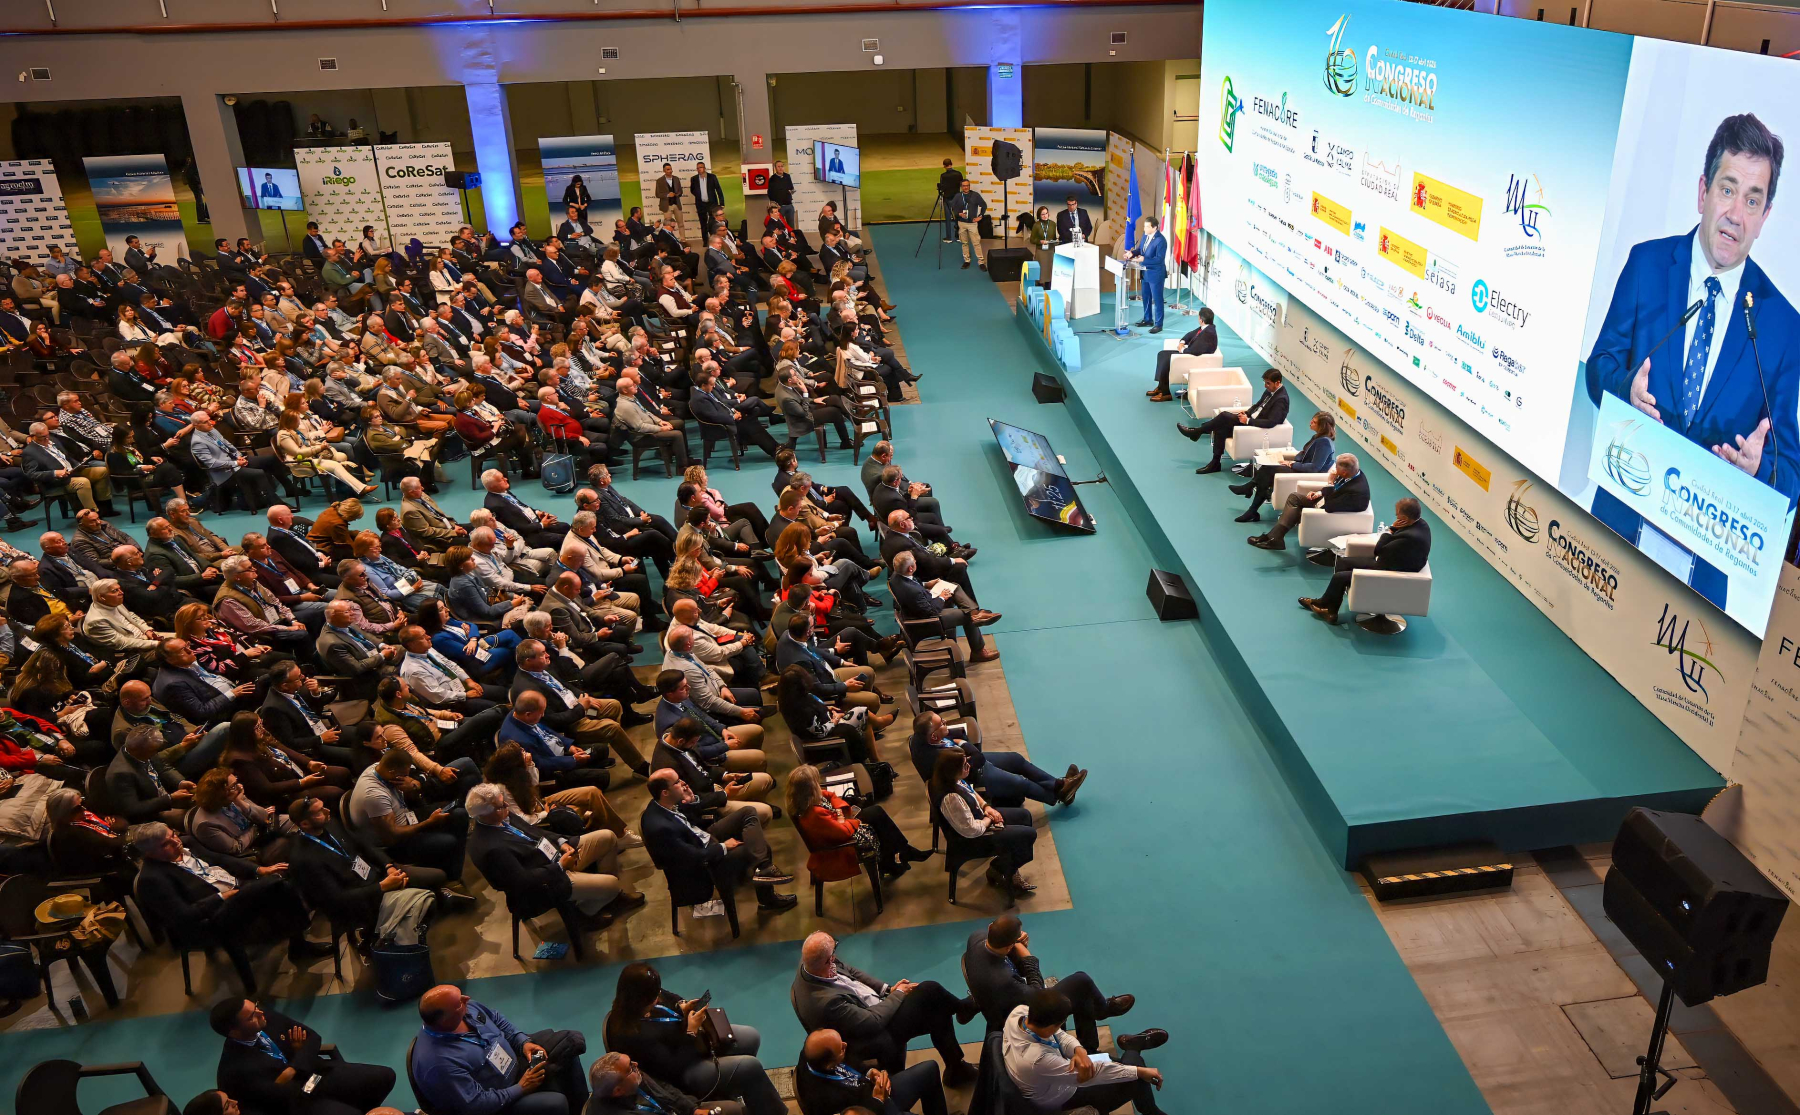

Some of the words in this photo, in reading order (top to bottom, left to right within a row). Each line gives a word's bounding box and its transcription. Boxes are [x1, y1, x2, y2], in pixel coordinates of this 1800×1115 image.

[1366, 45, 1437, 95] CONGRESO
[1253, 92, 1298, 129] FENACORE
[385, 165, 448, 178] CoReSat
[643, 152, 704, 163] SPHERAG
[322, 176, 356, 186] iRiego
[1425, 269, 1456, 295] seiasa
[1490, 290, 1528, 328] Electry
[1457, 324, 1486, 349] Amiblu
[1365, 375, 1405, 419] CONGRESO
[1662, 487, 1760, 566] NACIONAL
[1664, 467, 1764, 551] CONGRESO
[1692, 479, 1710, 496] Ciudad
[1711, 490, 1724, 505] Real
[1740, 506, 1753, 523] abril
[1753, 516, 1768, 532] 2026
[1548, 520, 1618, 589] CONGRESO
[1660, 505, 1669, 516] de
[1670, 510, 1713, 546] Comunidades
[1714, 542, 1724, 554] de
[1725, 545, 1758, 577] Regantes
[1546, 537, 1615, 602] NACIONAL
